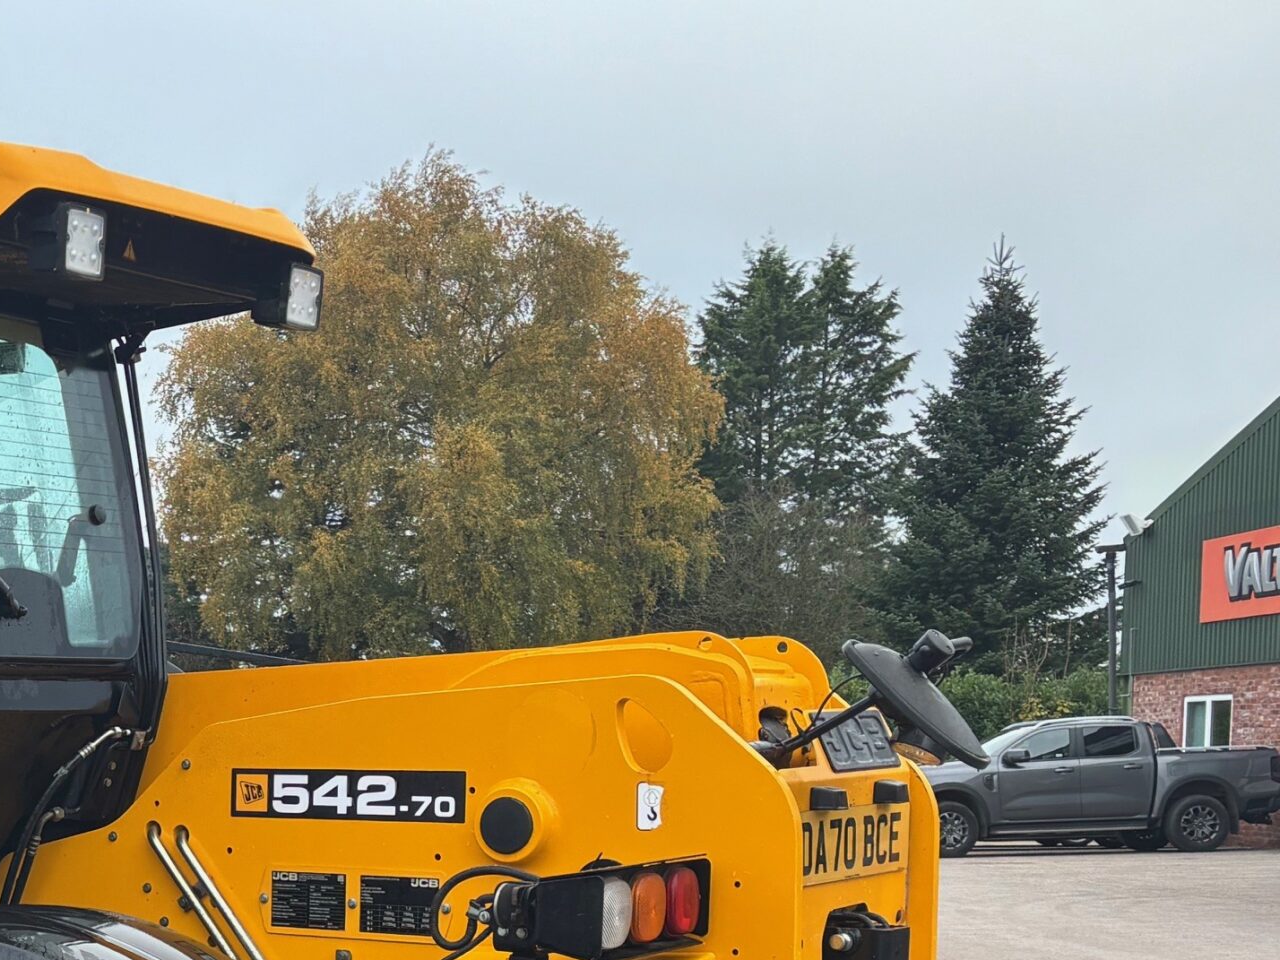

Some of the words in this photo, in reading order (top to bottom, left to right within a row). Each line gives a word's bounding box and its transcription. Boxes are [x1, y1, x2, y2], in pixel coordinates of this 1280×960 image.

[240, 781, 264, 804] JCB
[272, 774, 456, 818] 542-70
[803, 816, 857, 877] DA70
[863, 812, 901, 867] BCE
[272, 872, 298, 881] JCB
[410, 878, 439, 888] JCB
